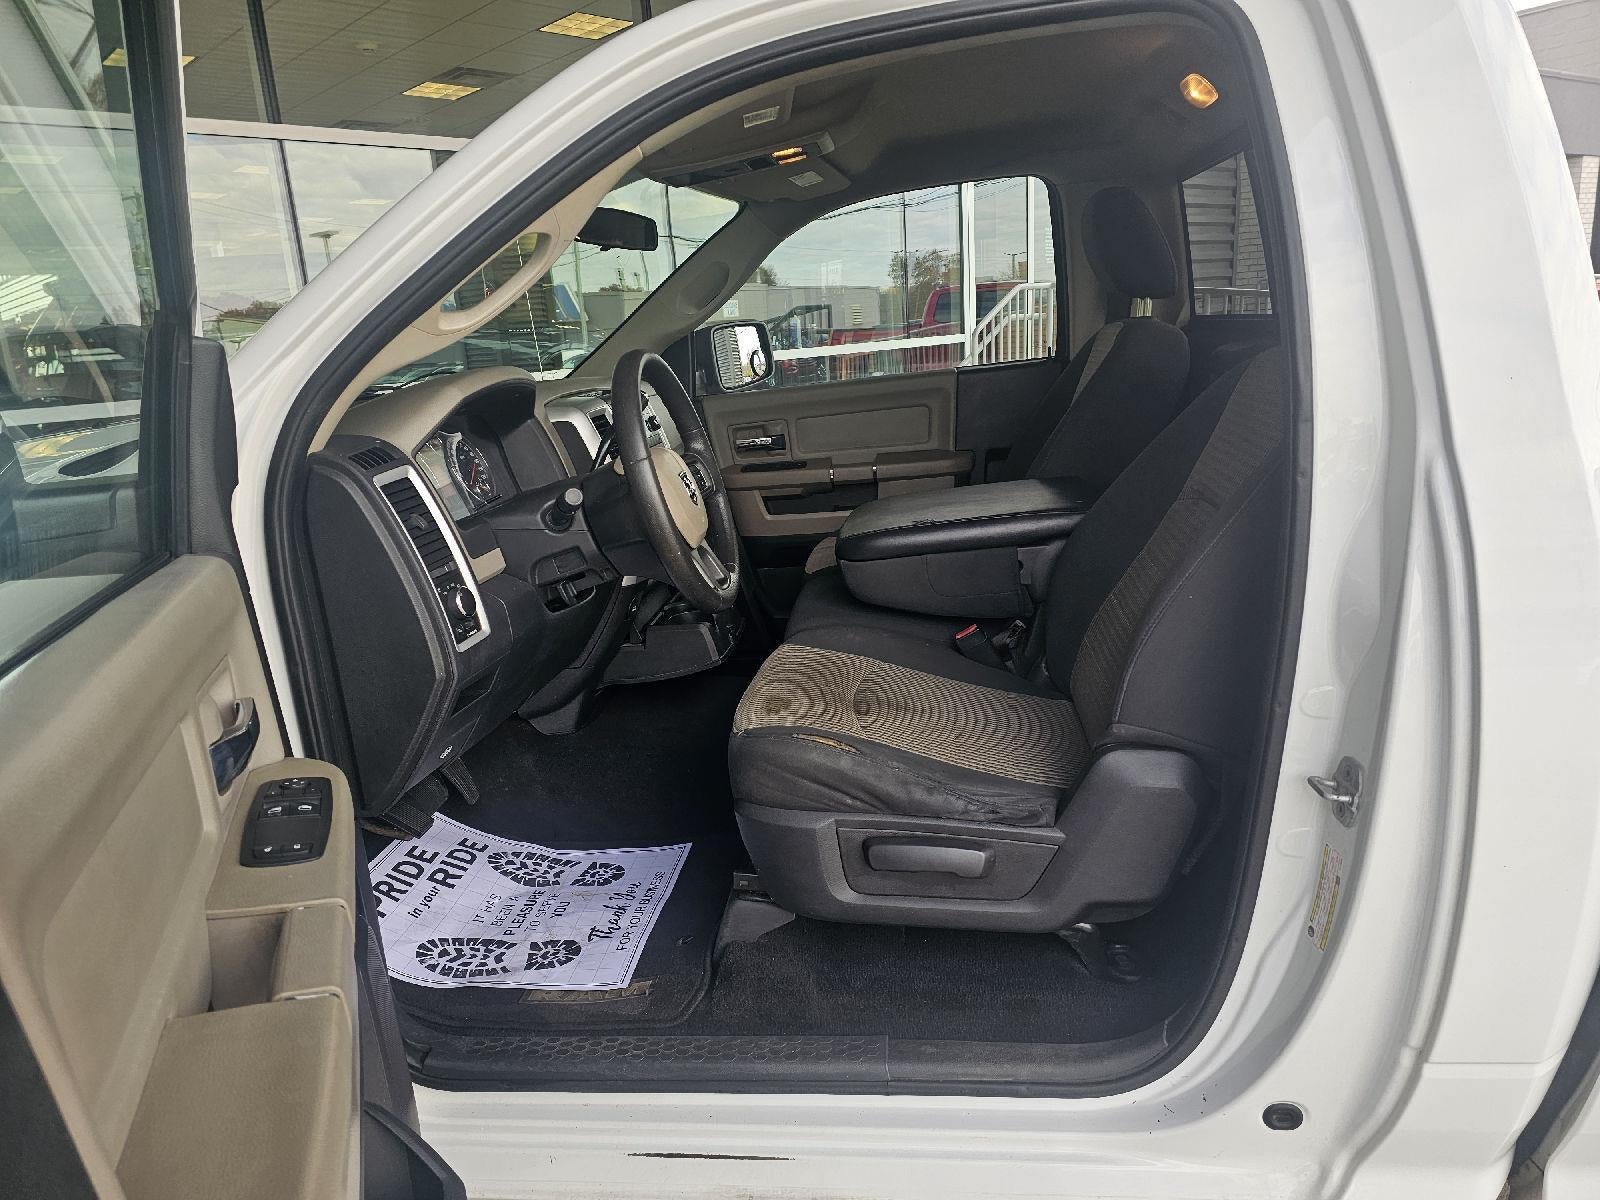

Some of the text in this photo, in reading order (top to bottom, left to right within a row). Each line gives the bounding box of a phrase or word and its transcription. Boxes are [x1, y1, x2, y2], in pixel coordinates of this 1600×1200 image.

[408, 838, 489, 919] in your RIDE
[472, 913, 485, 924] IT
[490, 904, 516, 927] BEEN
[502, 889, 546, 936] PLEASURE
[524, 920, 541, 932] TO
[550, 901, 571, 919] YOU
[588, 881, 641, 942] Thank You
[616, 931, 634, 951] FOR
[626, 905, 647, 930] YOUR
